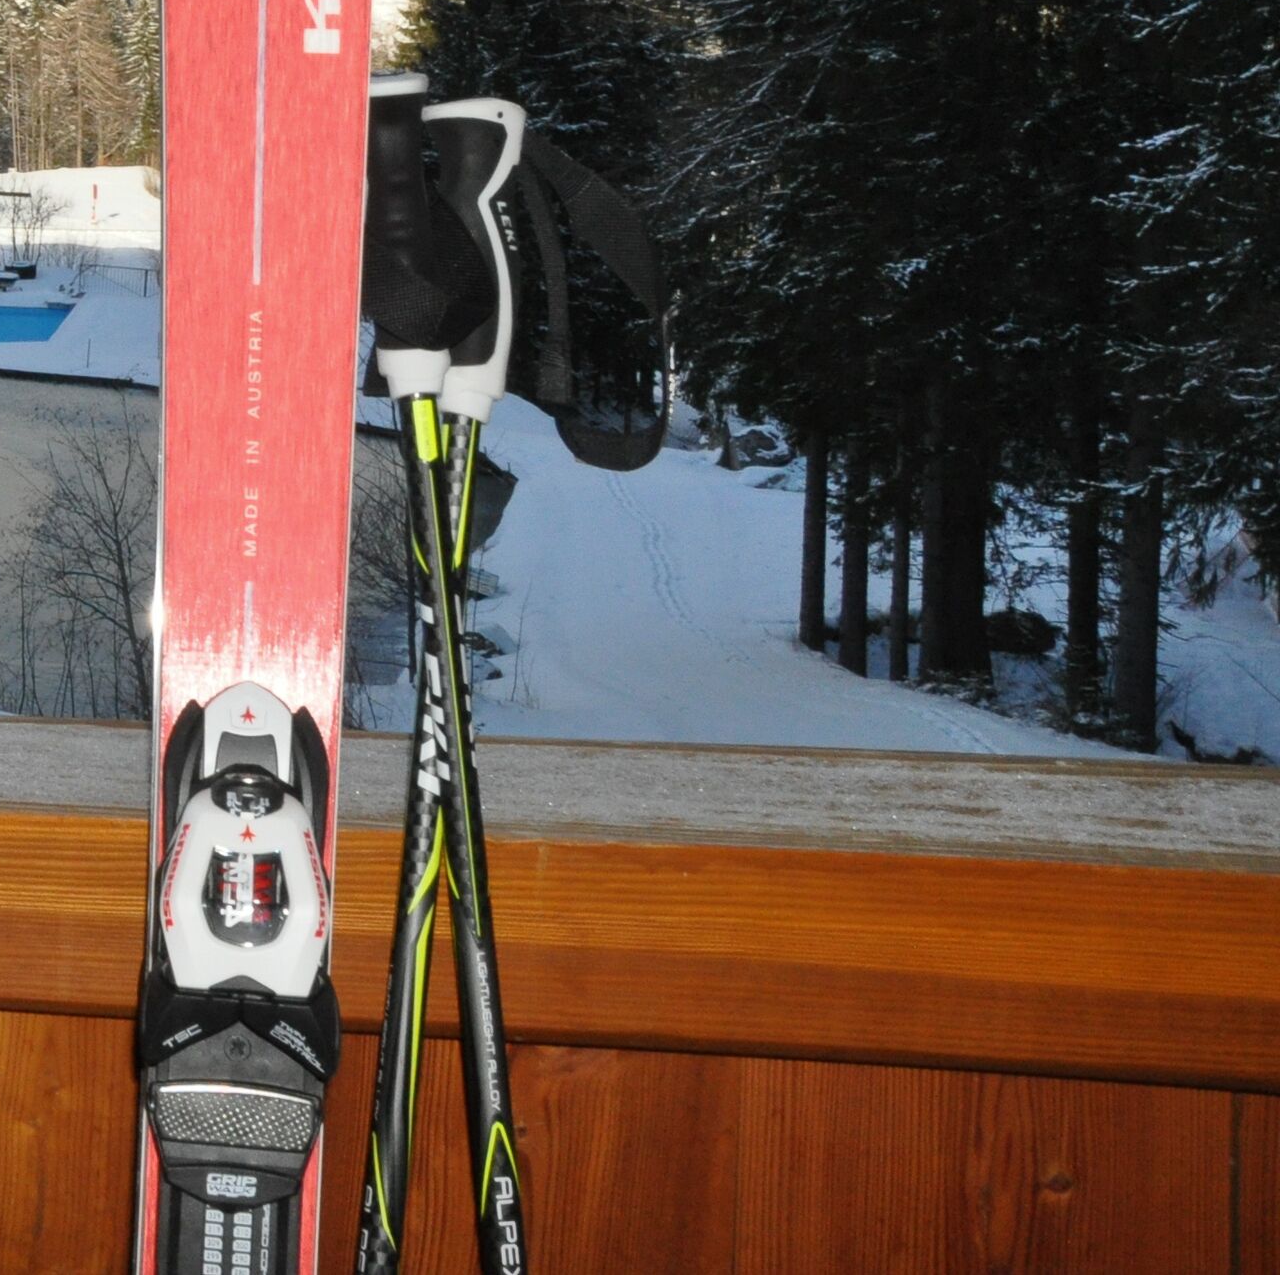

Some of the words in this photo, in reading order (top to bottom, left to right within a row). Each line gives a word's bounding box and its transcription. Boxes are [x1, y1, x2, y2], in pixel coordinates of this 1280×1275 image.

[496, 200, 518, 252] LEKI
[247, 310, 263, 419] AUSTRIA
[245, 440, 260, 464] IN
[244, 486, 259, 557] MADE
[162, 1023, 203, 1048] TSC
[270, 1030, 325, 1073] CONTROL
[476, 951, 496, 1055] LIGHTWEIGHT
[487, 1059, 501, 1111] ALLOY
[206, 1173, 258, 1187] GRIP
